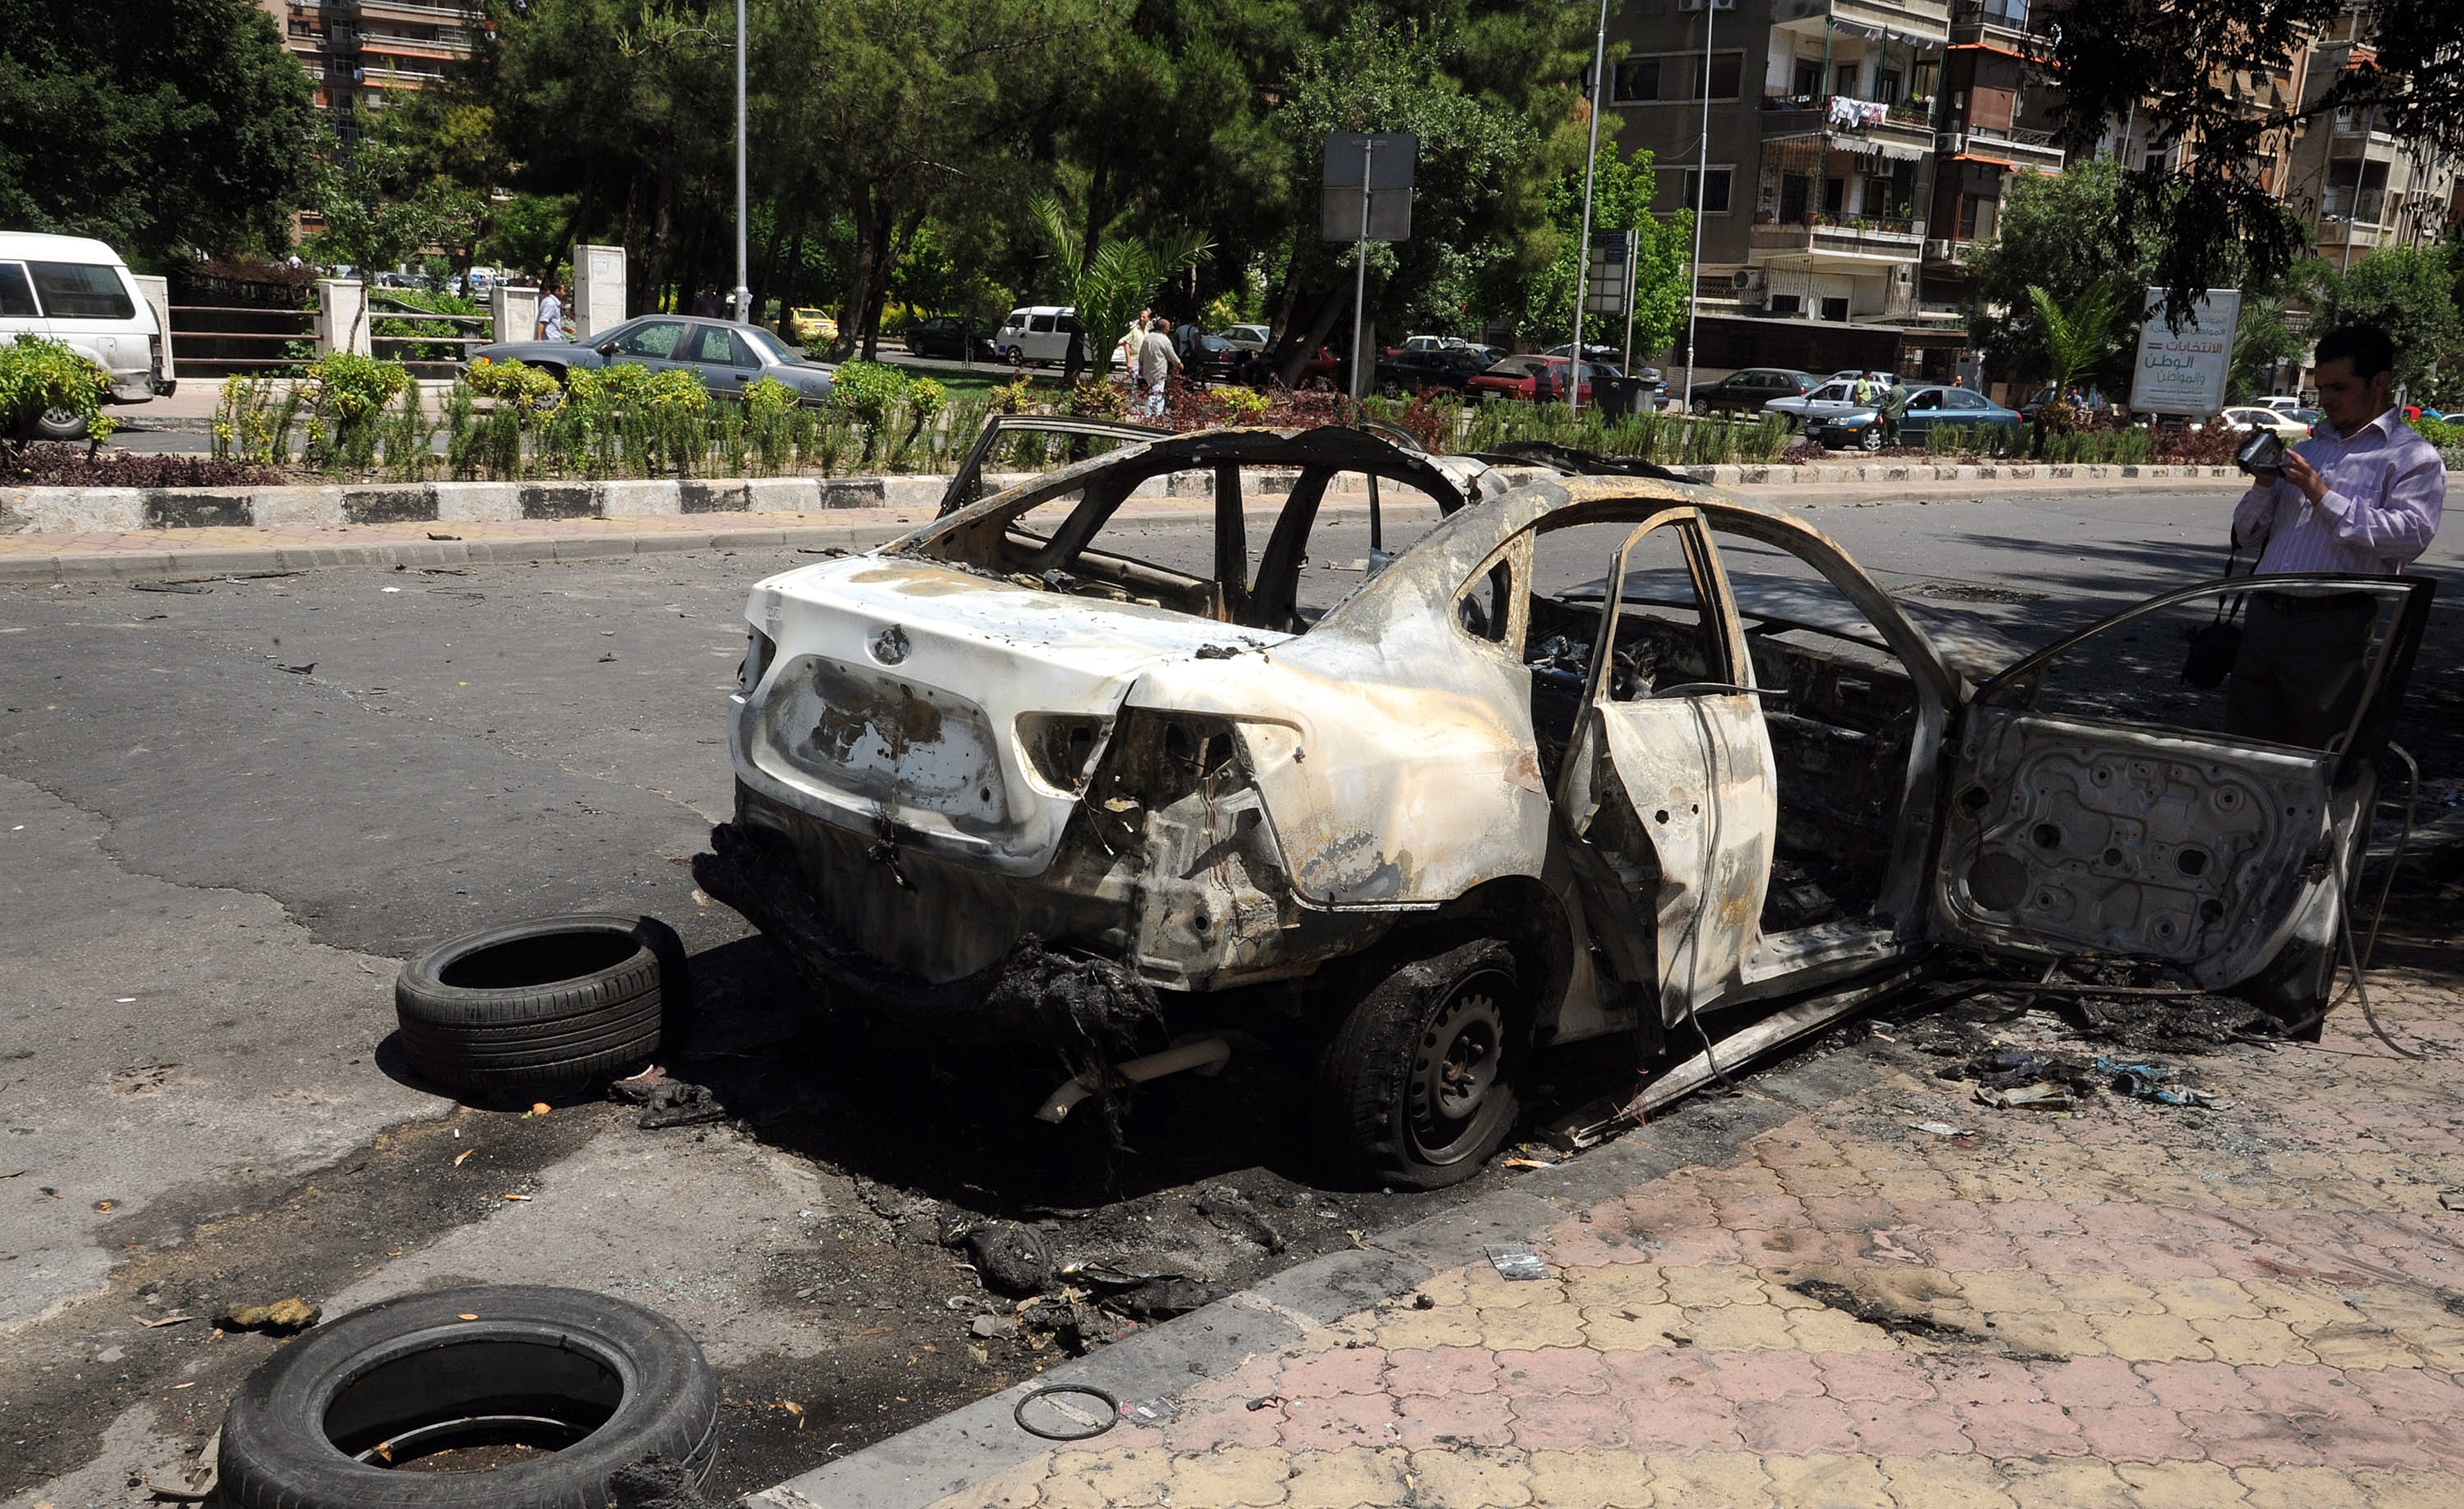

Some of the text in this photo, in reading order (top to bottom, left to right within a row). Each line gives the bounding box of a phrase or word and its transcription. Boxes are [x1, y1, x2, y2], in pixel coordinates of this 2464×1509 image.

[2166, 342, 2223, 355] الانتخابات
[2145, 353, 2194, 370] الوطن
[2157, 371, 2205, 386] والمواطن
